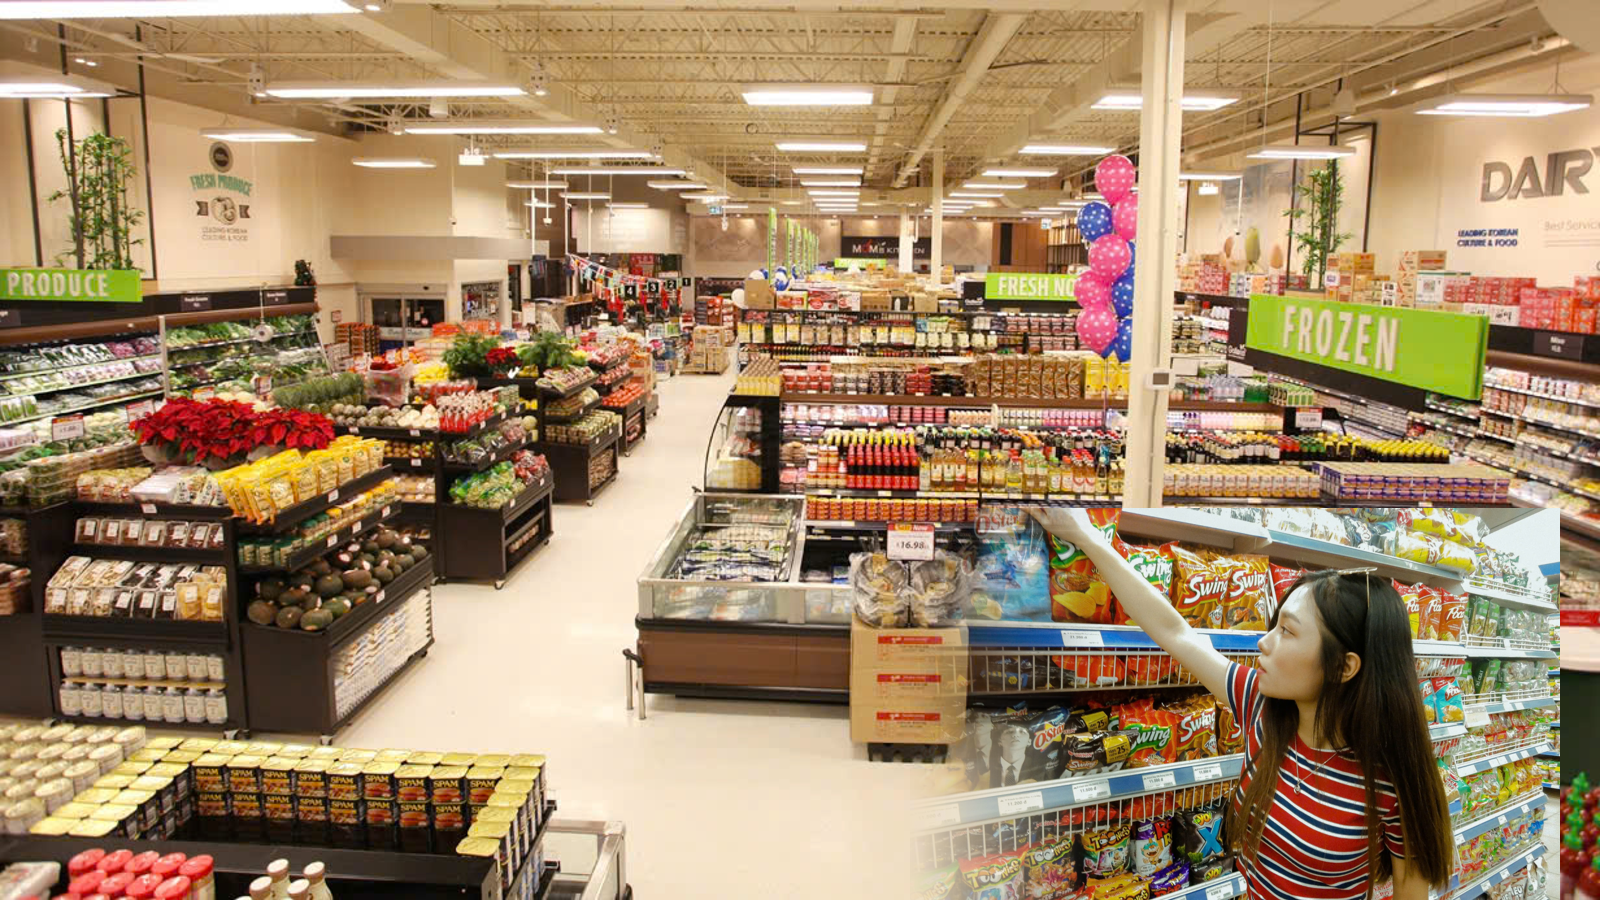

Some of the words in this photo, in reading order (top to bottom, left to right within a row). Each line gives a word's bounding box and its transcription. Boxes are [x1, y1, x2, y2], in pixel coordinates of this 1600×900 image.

[1481, 147, 1600, 202] DAIR
[1495, 239, 1518, 247] FOOD
[8, 272, 109, 297] PRODUCE
[998, 276, 1049, 297] FRESH
[626, 286, 634, 295] 4
[1283, 304, 1400, 373] FROZEN
[1184, 576, 1228, 605] Swing
[196, 768, 219, 776] SPAM
[231, 769, 253, 777] SPAM
[263, 770, 287, 779] SPAM
[299, 773, 321, 781] SPAM
[330, 776, 354, 784] SPAM
[364, 774, 389, 783] SPAM
[398, 778, 425, 788] SPAM
[433, 779, 459, 788] SPAM
[470, 779, 496, 788] SPAM
[266, 795, 290, 804] SPAM
[300, 798, 323, 806] SPAM
[331, 801, 354, 809] SPAM
[367, 801, 390, 809] SPAM
[400, 804, 426, 812] SPAM
[435, 804, 461, 813] SPAM
